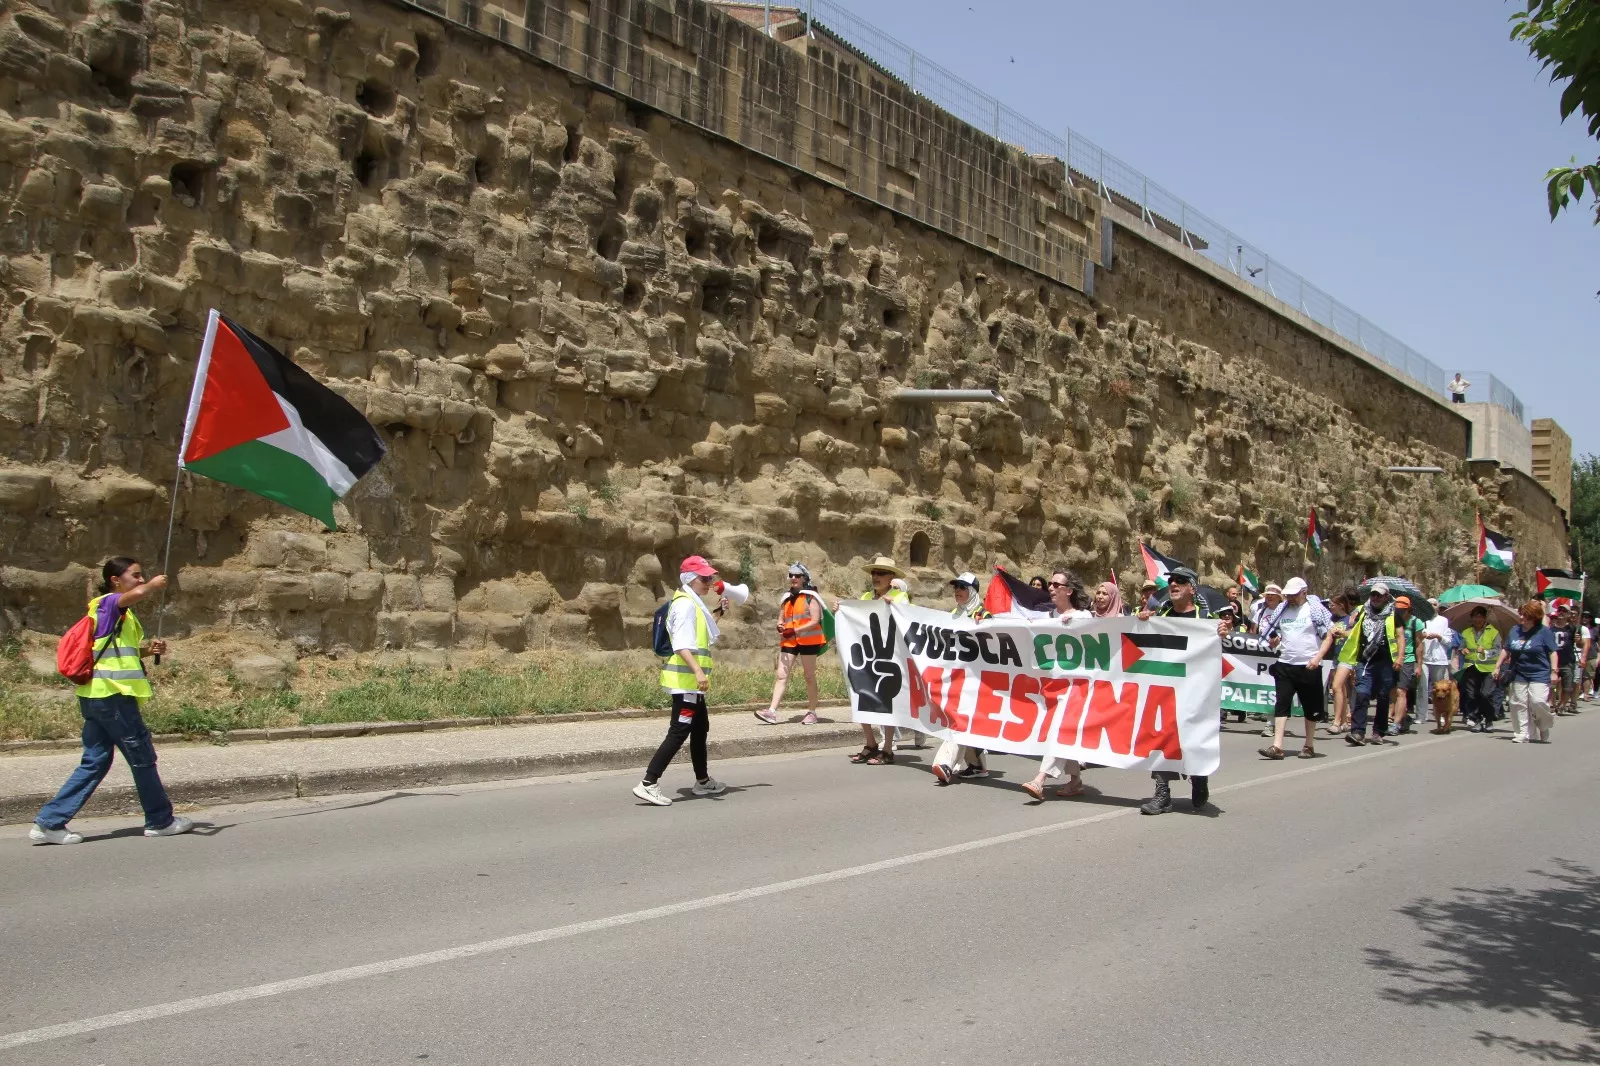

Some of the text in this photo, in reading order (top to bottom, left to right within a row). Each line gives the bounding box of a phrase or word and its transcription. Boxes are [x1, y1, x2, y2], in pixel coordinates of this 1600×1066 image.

[904, 621, 1110, 672] HUESCA CON
[907, 658, 1182, 761] PALESTINA
